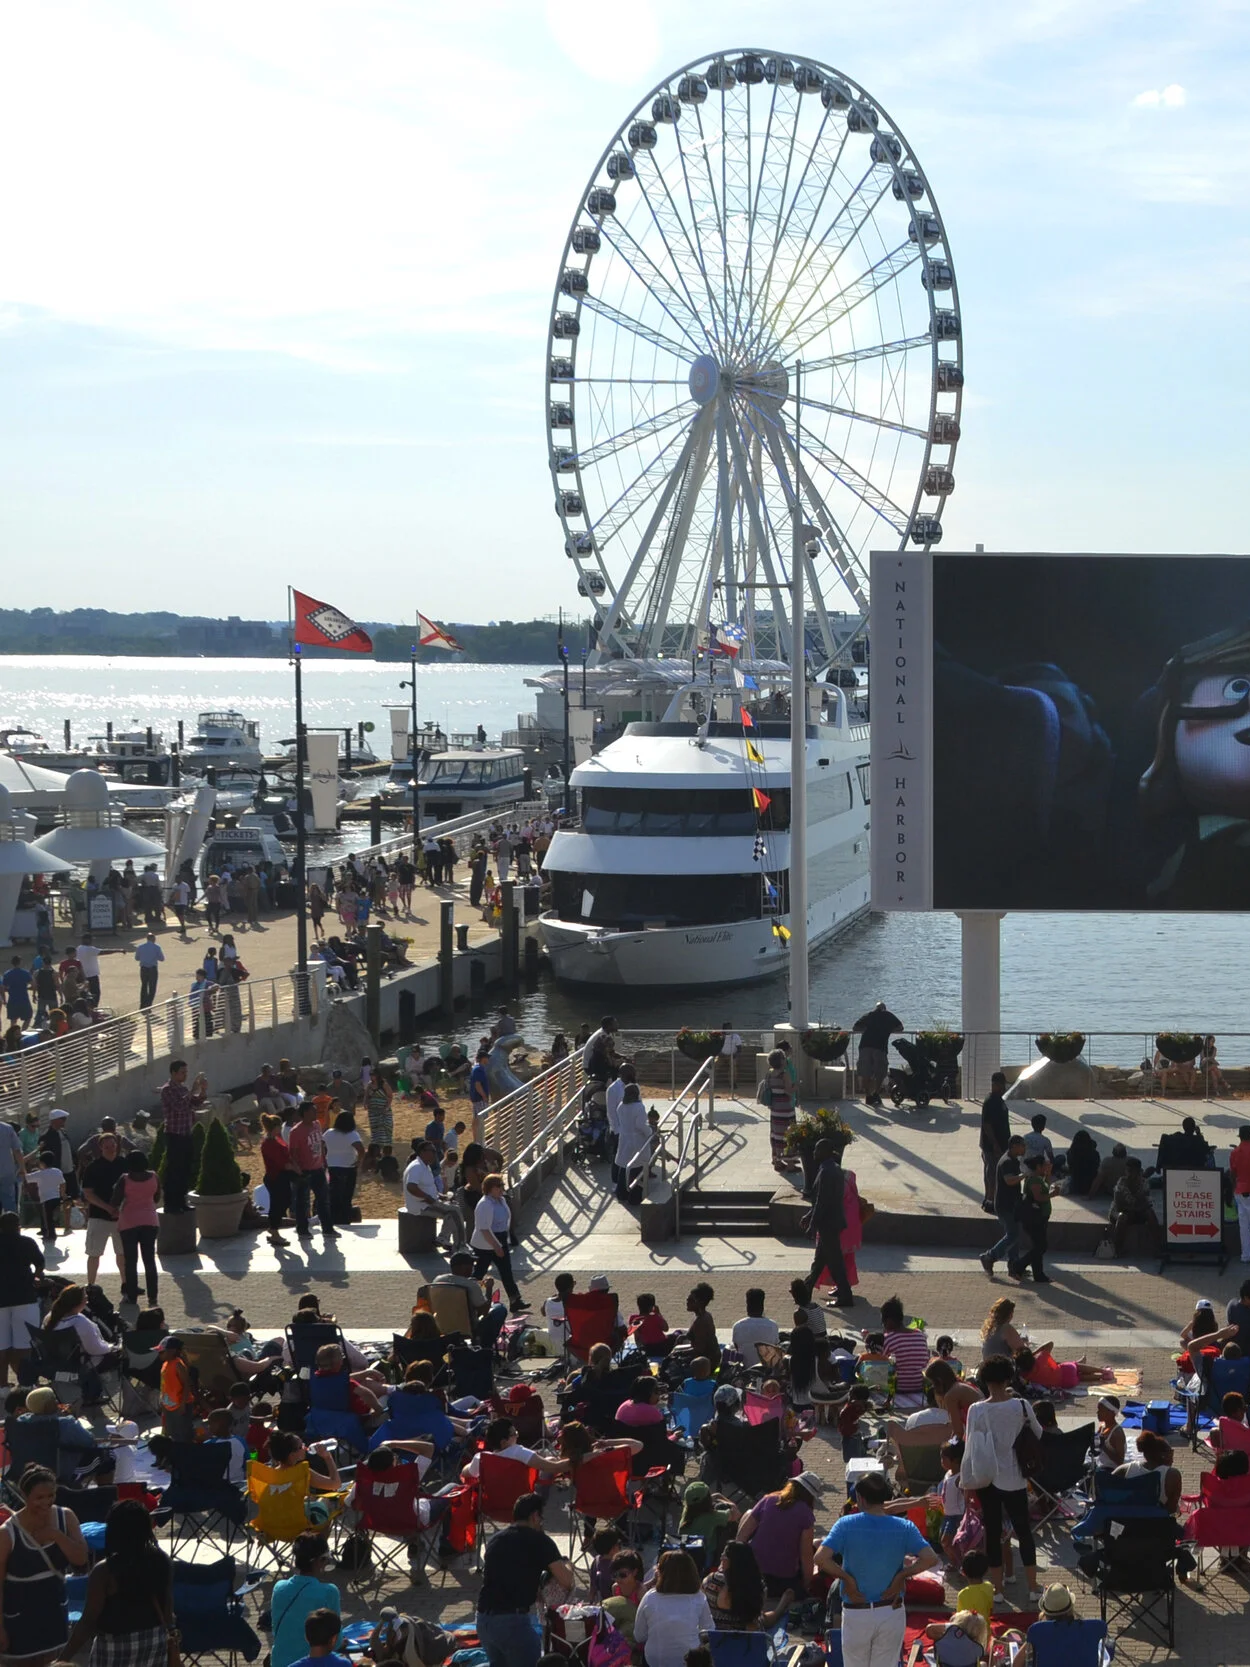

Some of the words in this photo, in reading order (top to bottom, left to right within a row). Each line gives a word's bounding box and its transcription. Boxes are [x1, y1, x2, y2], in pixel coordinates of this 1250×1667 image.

[894, 581, 906, 724] NATIONAL
[220, 830, 254, 839] TICKETS
[894, 777, 907, 883] HARBOR
[684, 931, 718, 945] National
[1174, 1191, 1213, 1200] PLEASE
[1172, 1200, 1193, 1209] USE
[1195, 1201, 1215, 1210] THE
[1175, 1210, 1212, 1219] STAIRS
